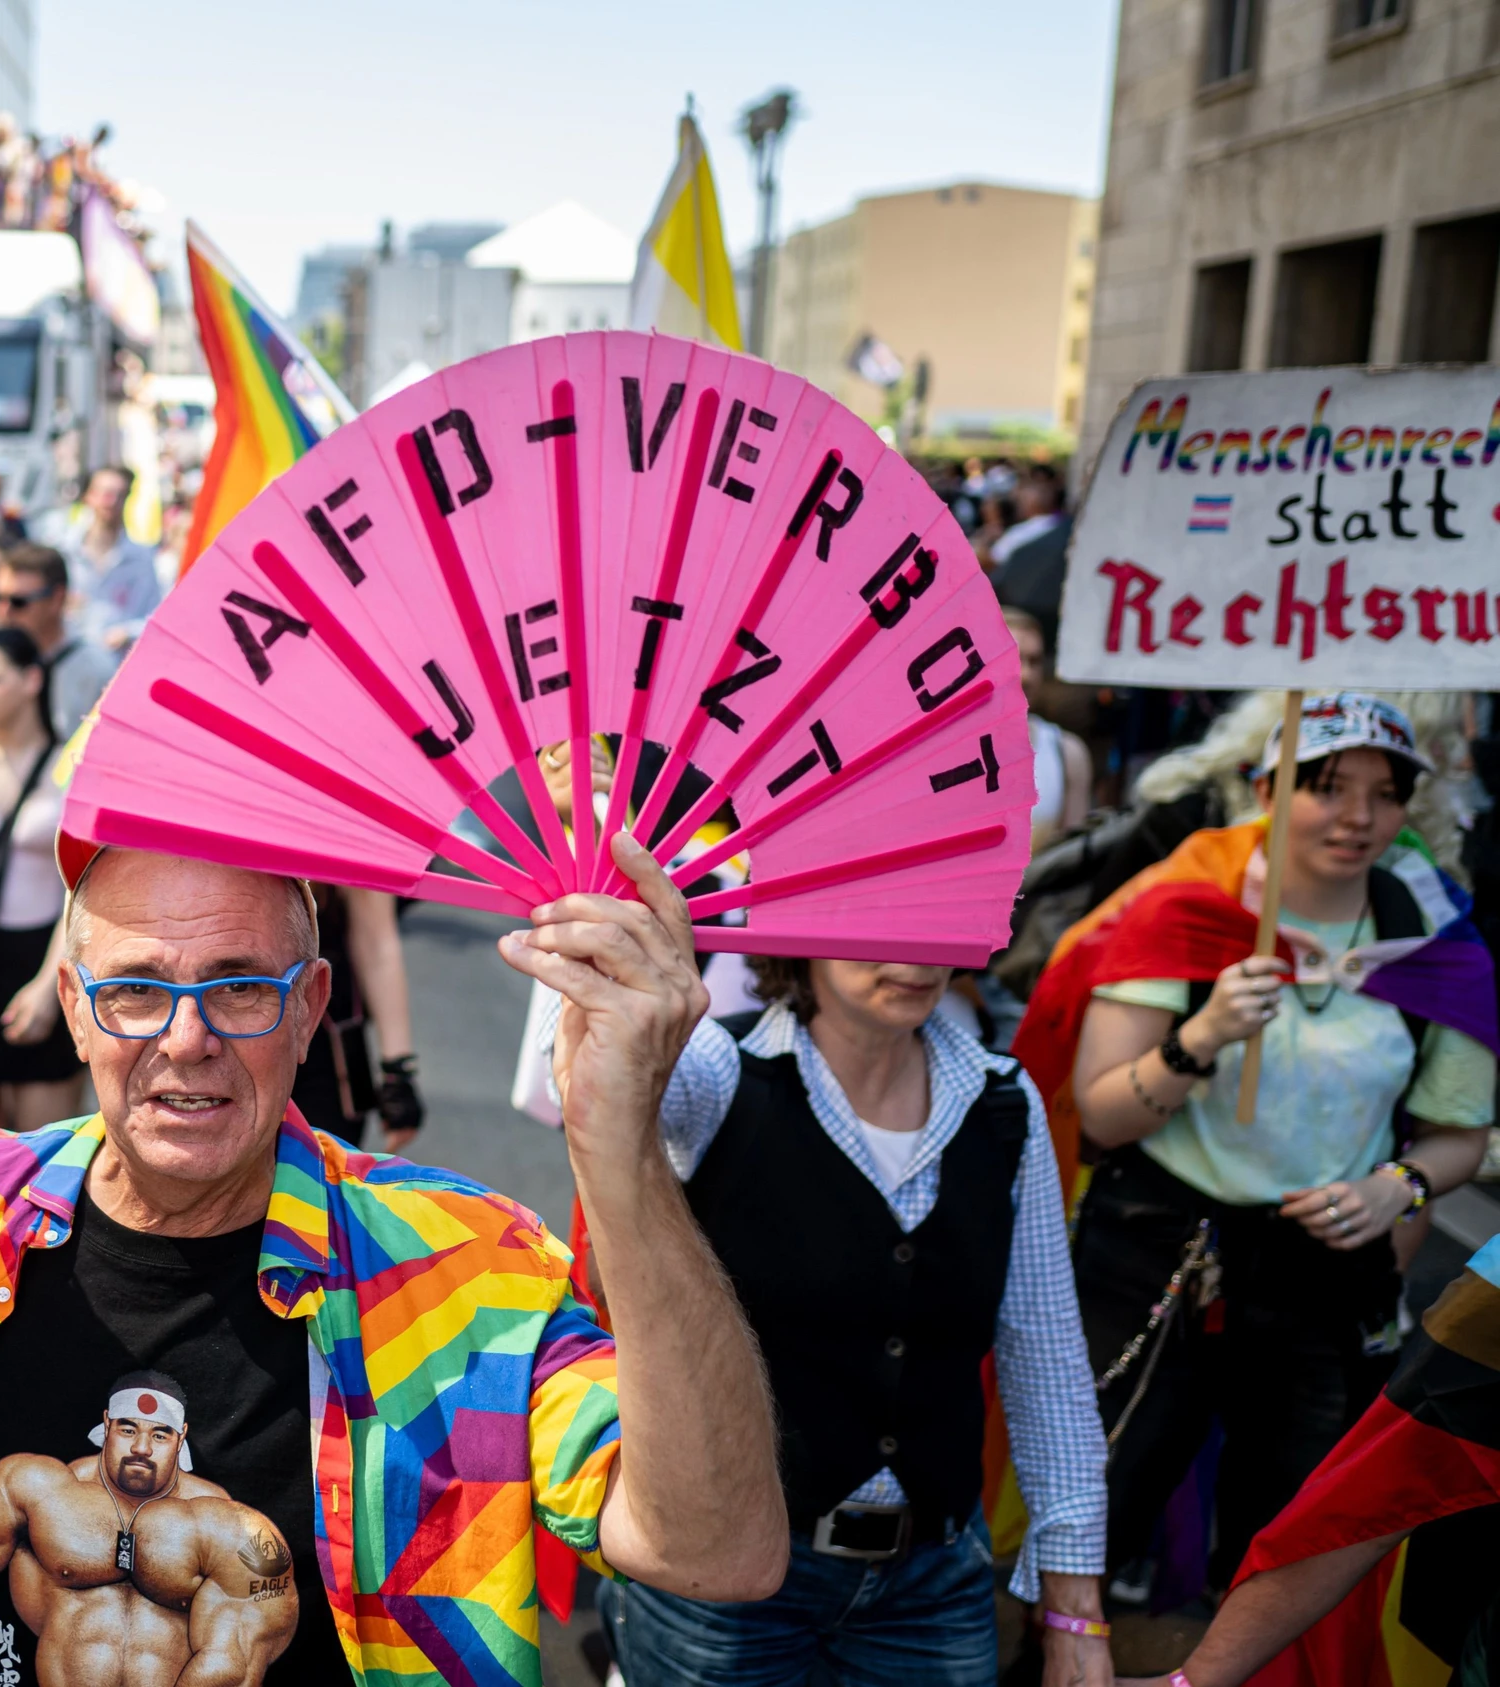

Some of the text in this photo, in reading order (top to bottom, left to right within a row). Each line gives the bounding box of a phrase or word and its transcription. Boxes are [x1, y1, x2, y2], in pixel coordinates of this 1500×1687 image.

[220, 376, 1000, 794] AFD-VERBOT
[1095, 556, 1500, 663] Rechtsru
[412, 595, 843, 799] JETZT
[249, 1576, 290, 1596] EAGLE
[253, 1589, 286, 1602] OSAKA
